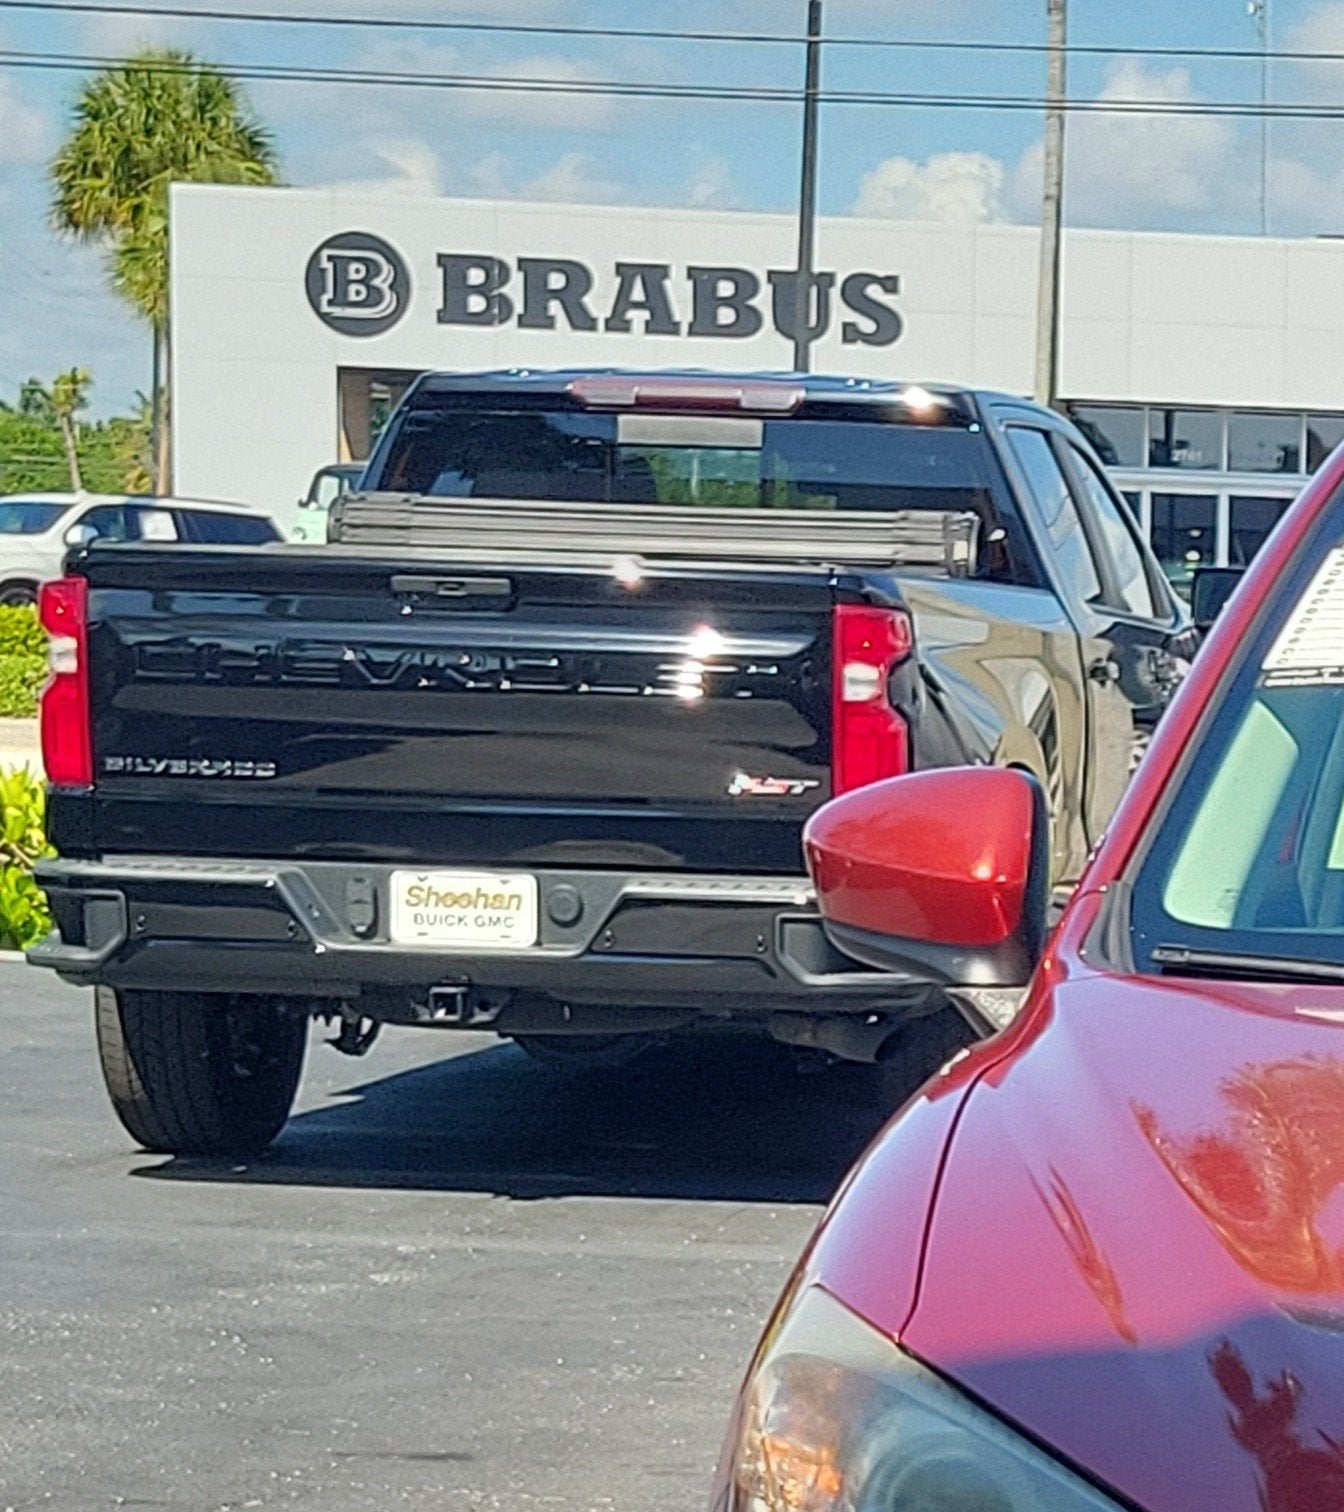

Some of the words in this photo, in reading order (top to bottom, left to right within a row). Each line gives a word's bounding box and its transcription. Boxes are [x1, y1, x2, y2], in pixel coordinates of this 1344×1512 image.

[436, 253, 904, 348] BRABUS
[104, 755, 277, 778] SILVERADO
[405, 885, 523, 911] Sheehan
[413, 912, 468, 927] BUICK
[474, 915, 514, 928] GMC
